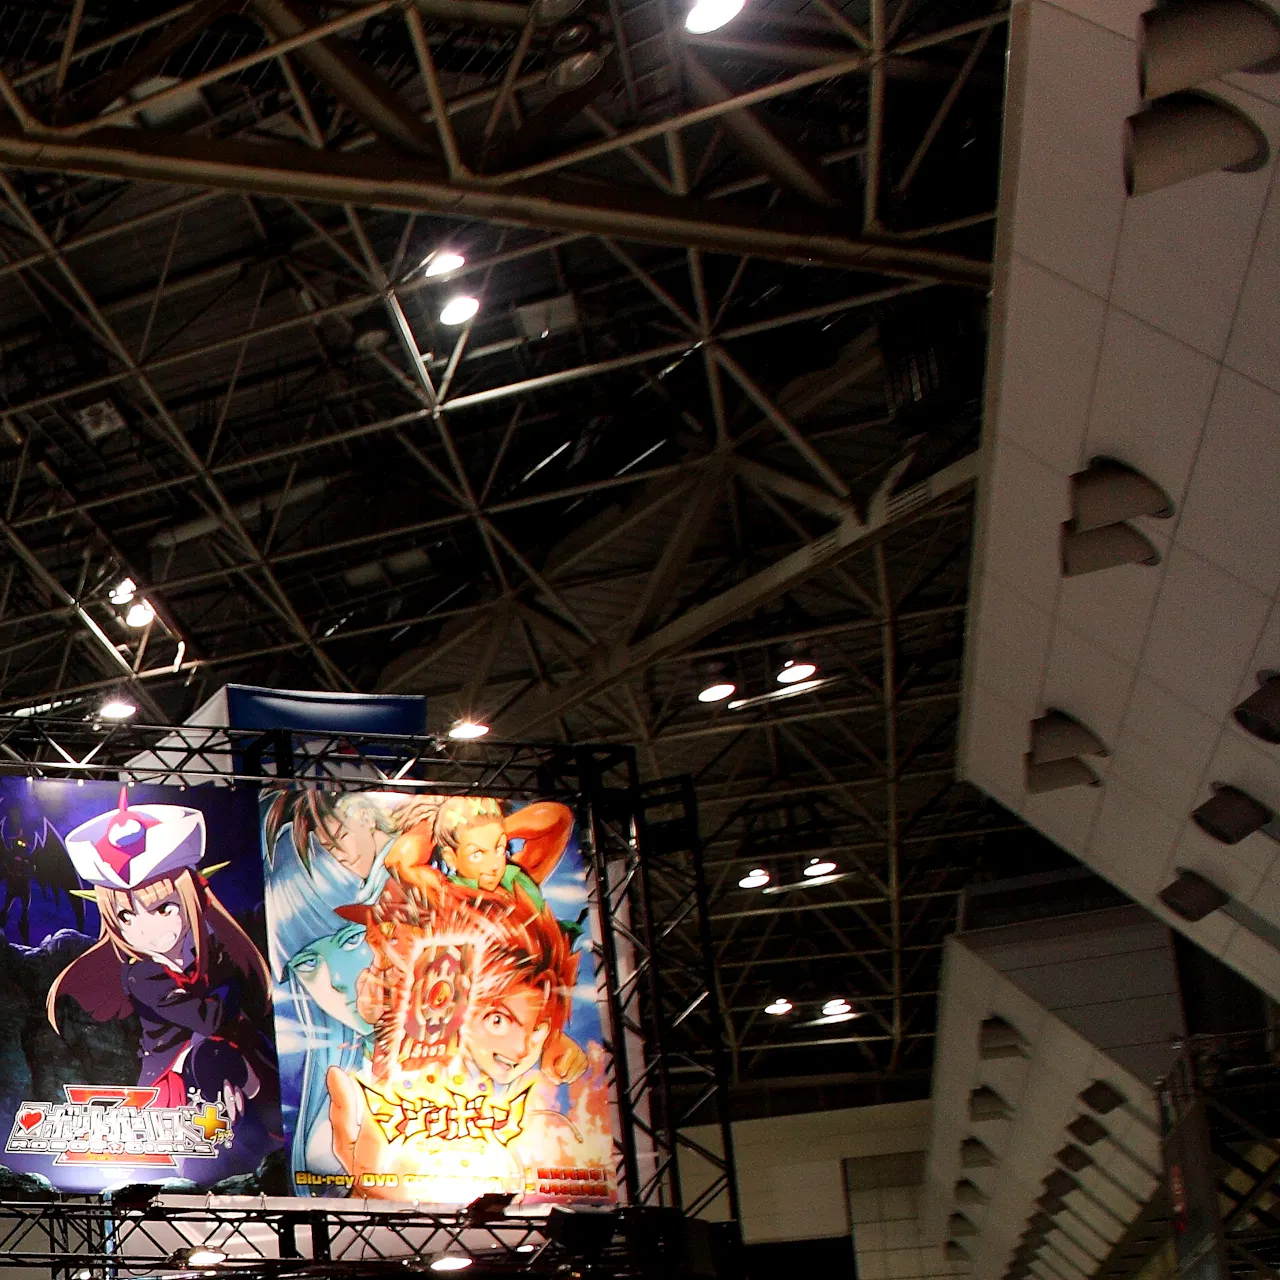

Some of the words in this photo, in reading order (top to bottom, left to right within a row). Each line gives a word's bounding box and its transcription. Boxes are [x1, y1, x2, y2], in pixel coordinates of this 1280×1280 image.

[356, 1077, 535, 1147] マジンボーン
[295, 1171, 354, 1188] Blu-ray
[362, 1173, 399, 1187] DVD
